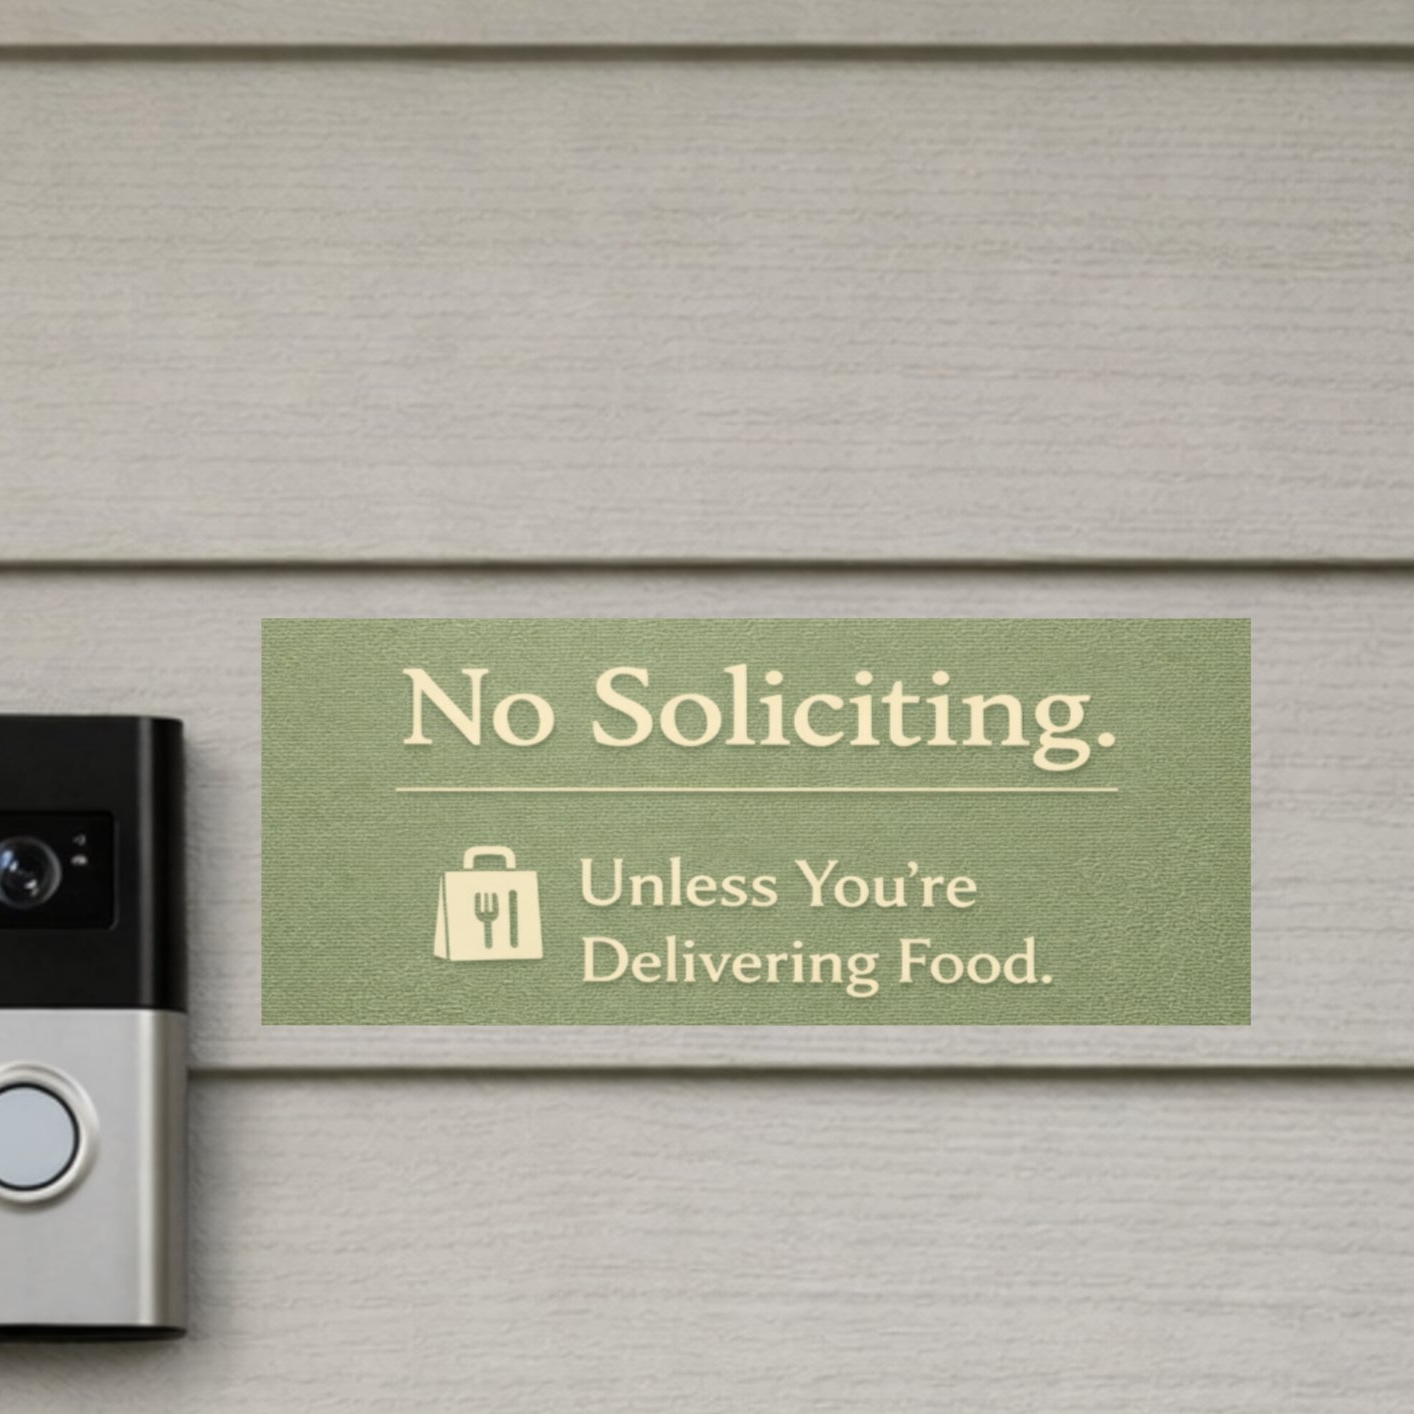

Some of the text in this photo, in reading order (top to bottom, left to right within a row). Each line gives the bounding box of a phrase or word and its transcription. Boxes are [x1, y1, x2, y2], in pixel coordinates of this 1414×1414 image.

[402, 663, 1116, 772] No Soliciting.
[580, 856, 977, 908] Unless You’re
[582, 935, 1053, 998] Delivering Food.
